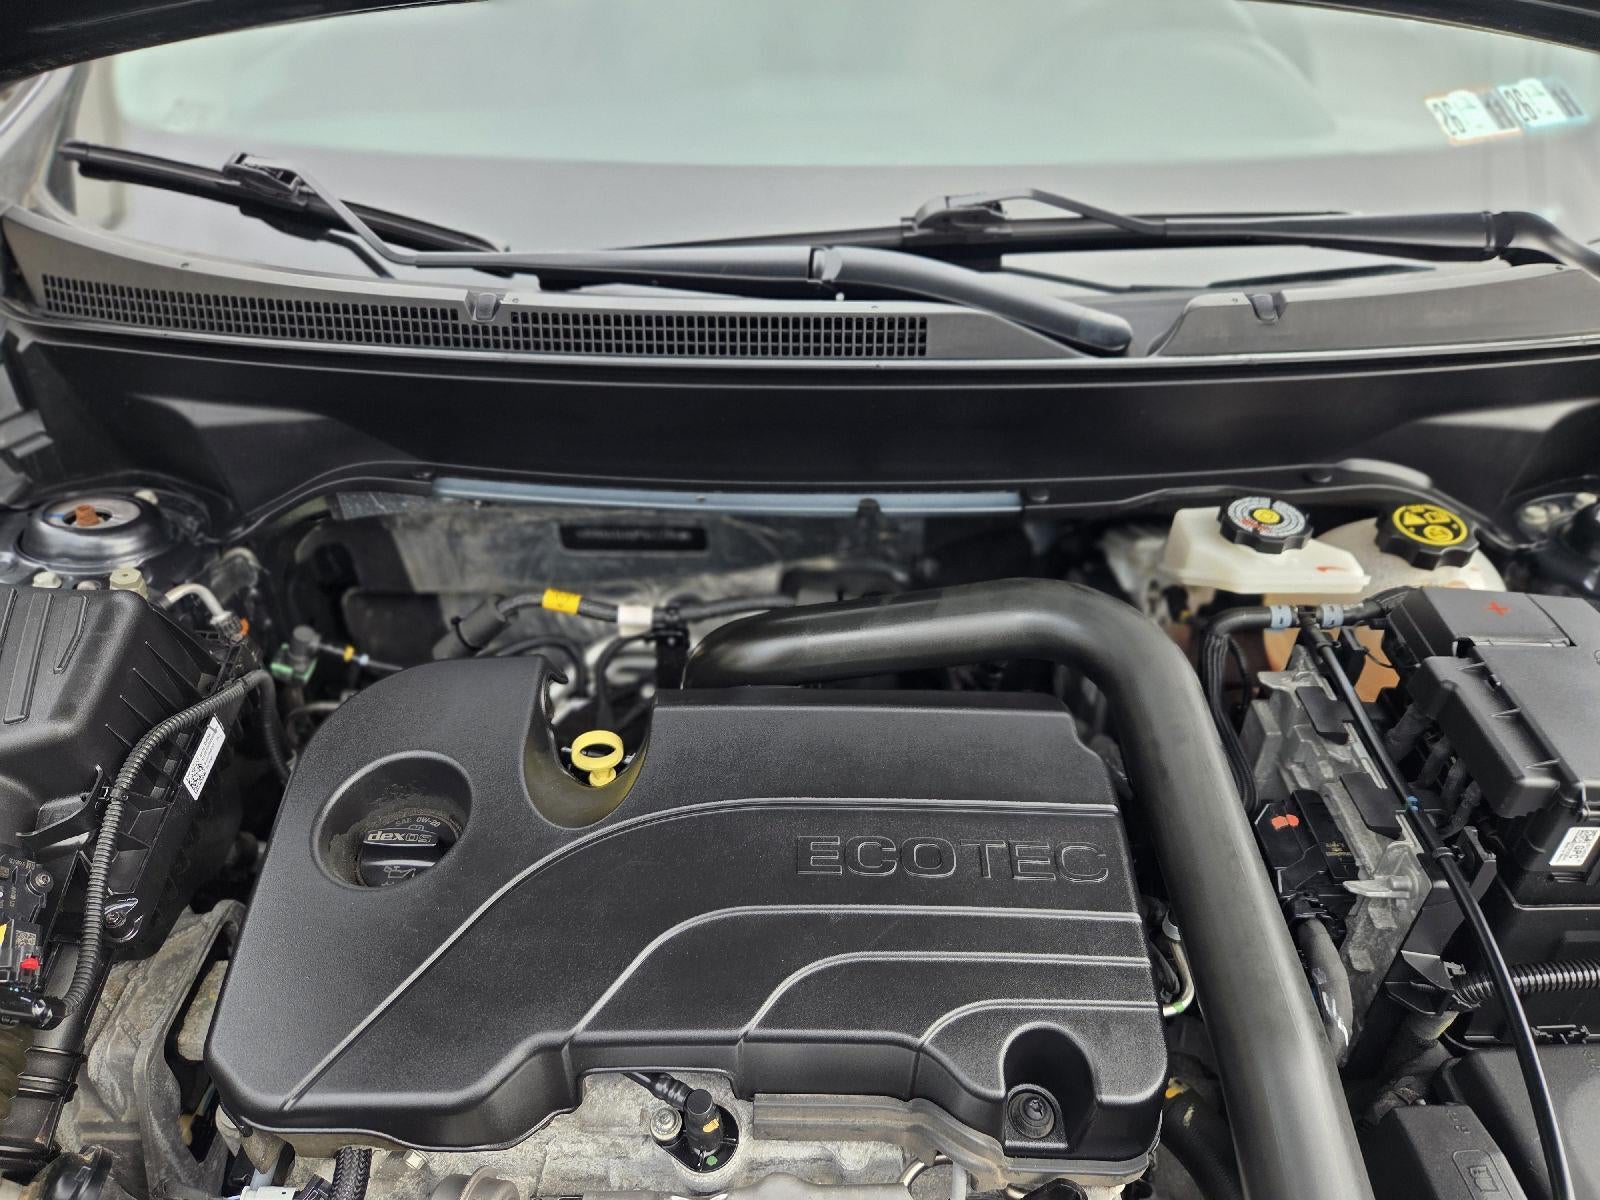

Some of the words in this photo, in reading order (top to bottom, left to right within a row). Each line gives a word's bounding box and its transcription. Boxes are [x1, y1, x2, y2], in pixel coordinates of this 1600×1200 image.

[1432, 100, 1467, 136] 26
[1503, 87, 1539, 122] 26
[796, 835, 1109, 883] ECOTEC
